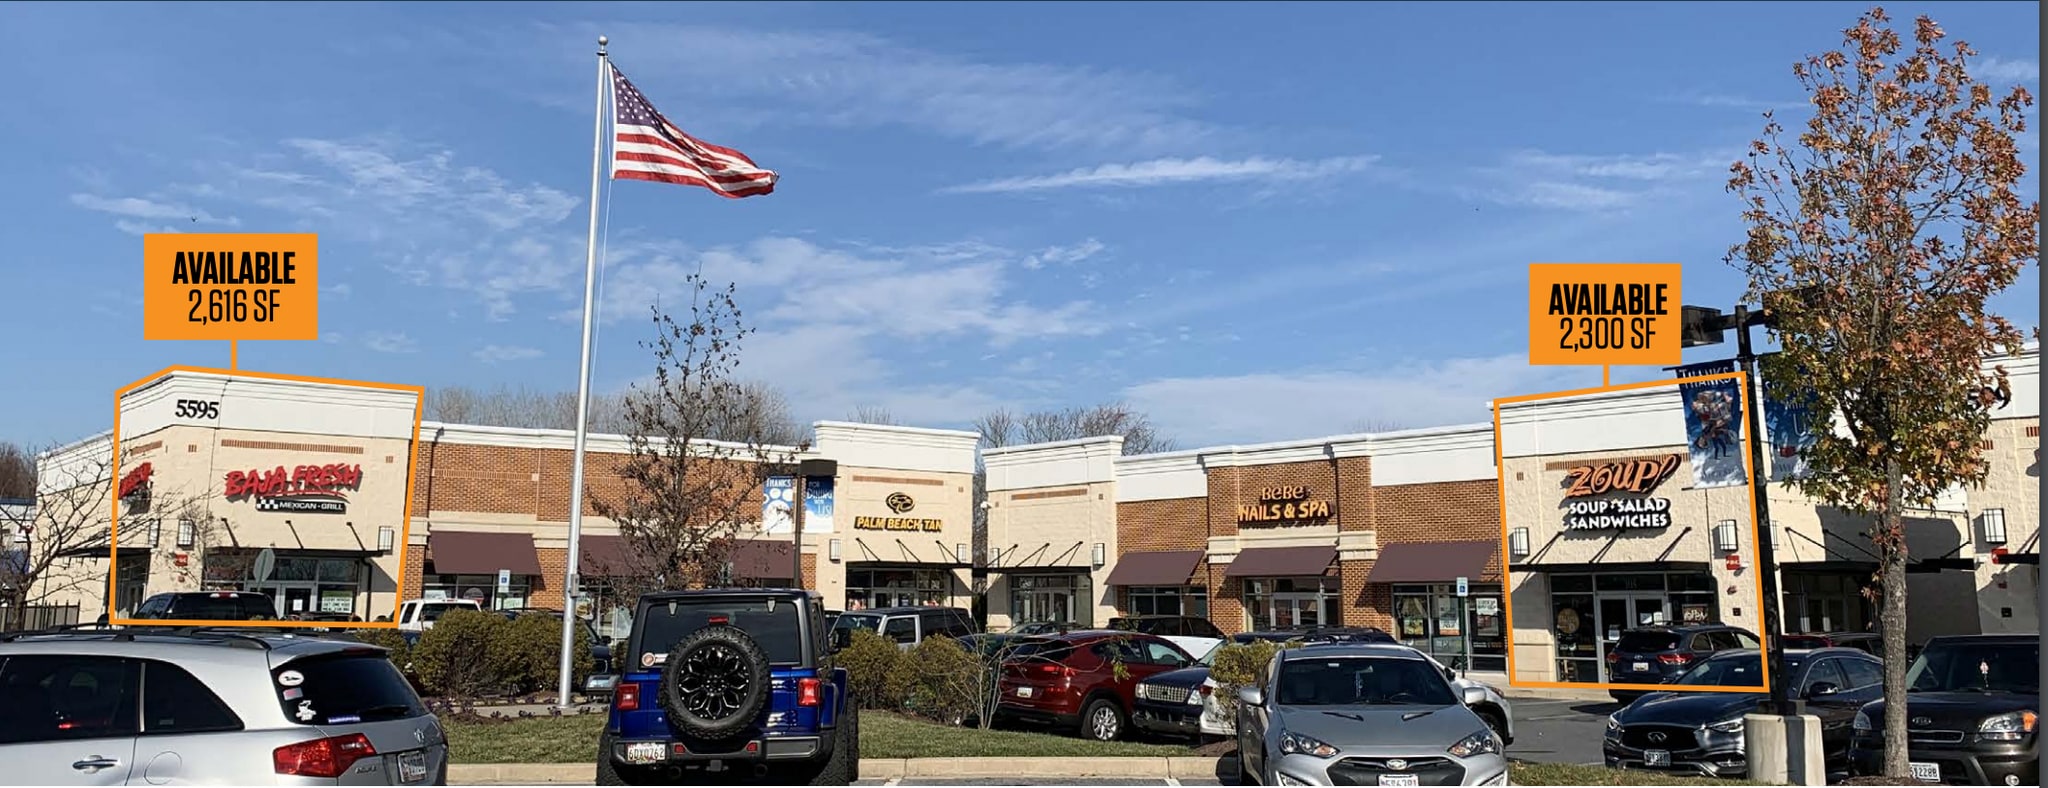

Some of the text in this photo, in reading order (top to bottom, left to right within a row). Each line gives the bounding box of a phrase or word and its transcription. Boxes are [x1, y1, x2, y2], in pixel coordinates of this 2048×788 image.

[1678, 366, 1732, 389] THANKS
[174, 399, 220, 420] 5595
[224, 463, 361, 499] BAJA FRESH
[766, 477, 792, 488] THANKS
[279, 501, 343, 511] MEXICAN GRILL
[1240, 500, 1329, 521] NAILS & SPA
[1570, 498, 1667, 514] SOUP SALAD
[855, 516, 943, 532] PALM BEACH TAN
[1570, 513, 1668, 529] SANDWICHES
